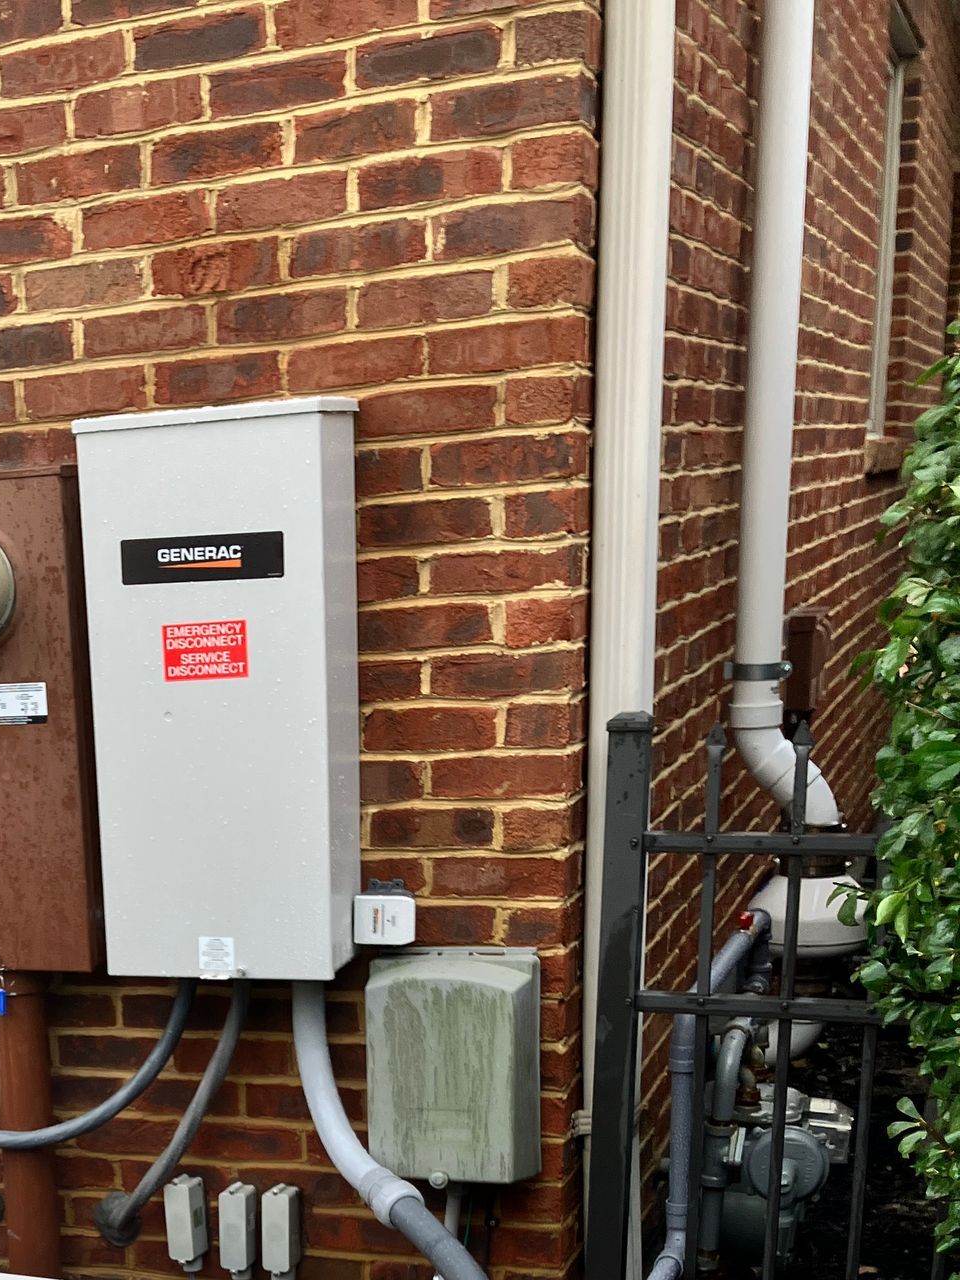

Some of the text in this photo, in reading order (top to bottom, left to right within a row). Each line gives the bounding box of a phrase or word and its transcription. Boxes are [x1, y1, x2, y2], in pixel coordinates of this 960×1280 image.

[157, 545, 242, 563] GENERAC
[166, 622, 242, 637] EMERGENCY
[166, 634, 243, 650] DISCONNECT
[180, 651, 231, 664] SERVICE
[167, 662, 245, 677] DISCONNECT
